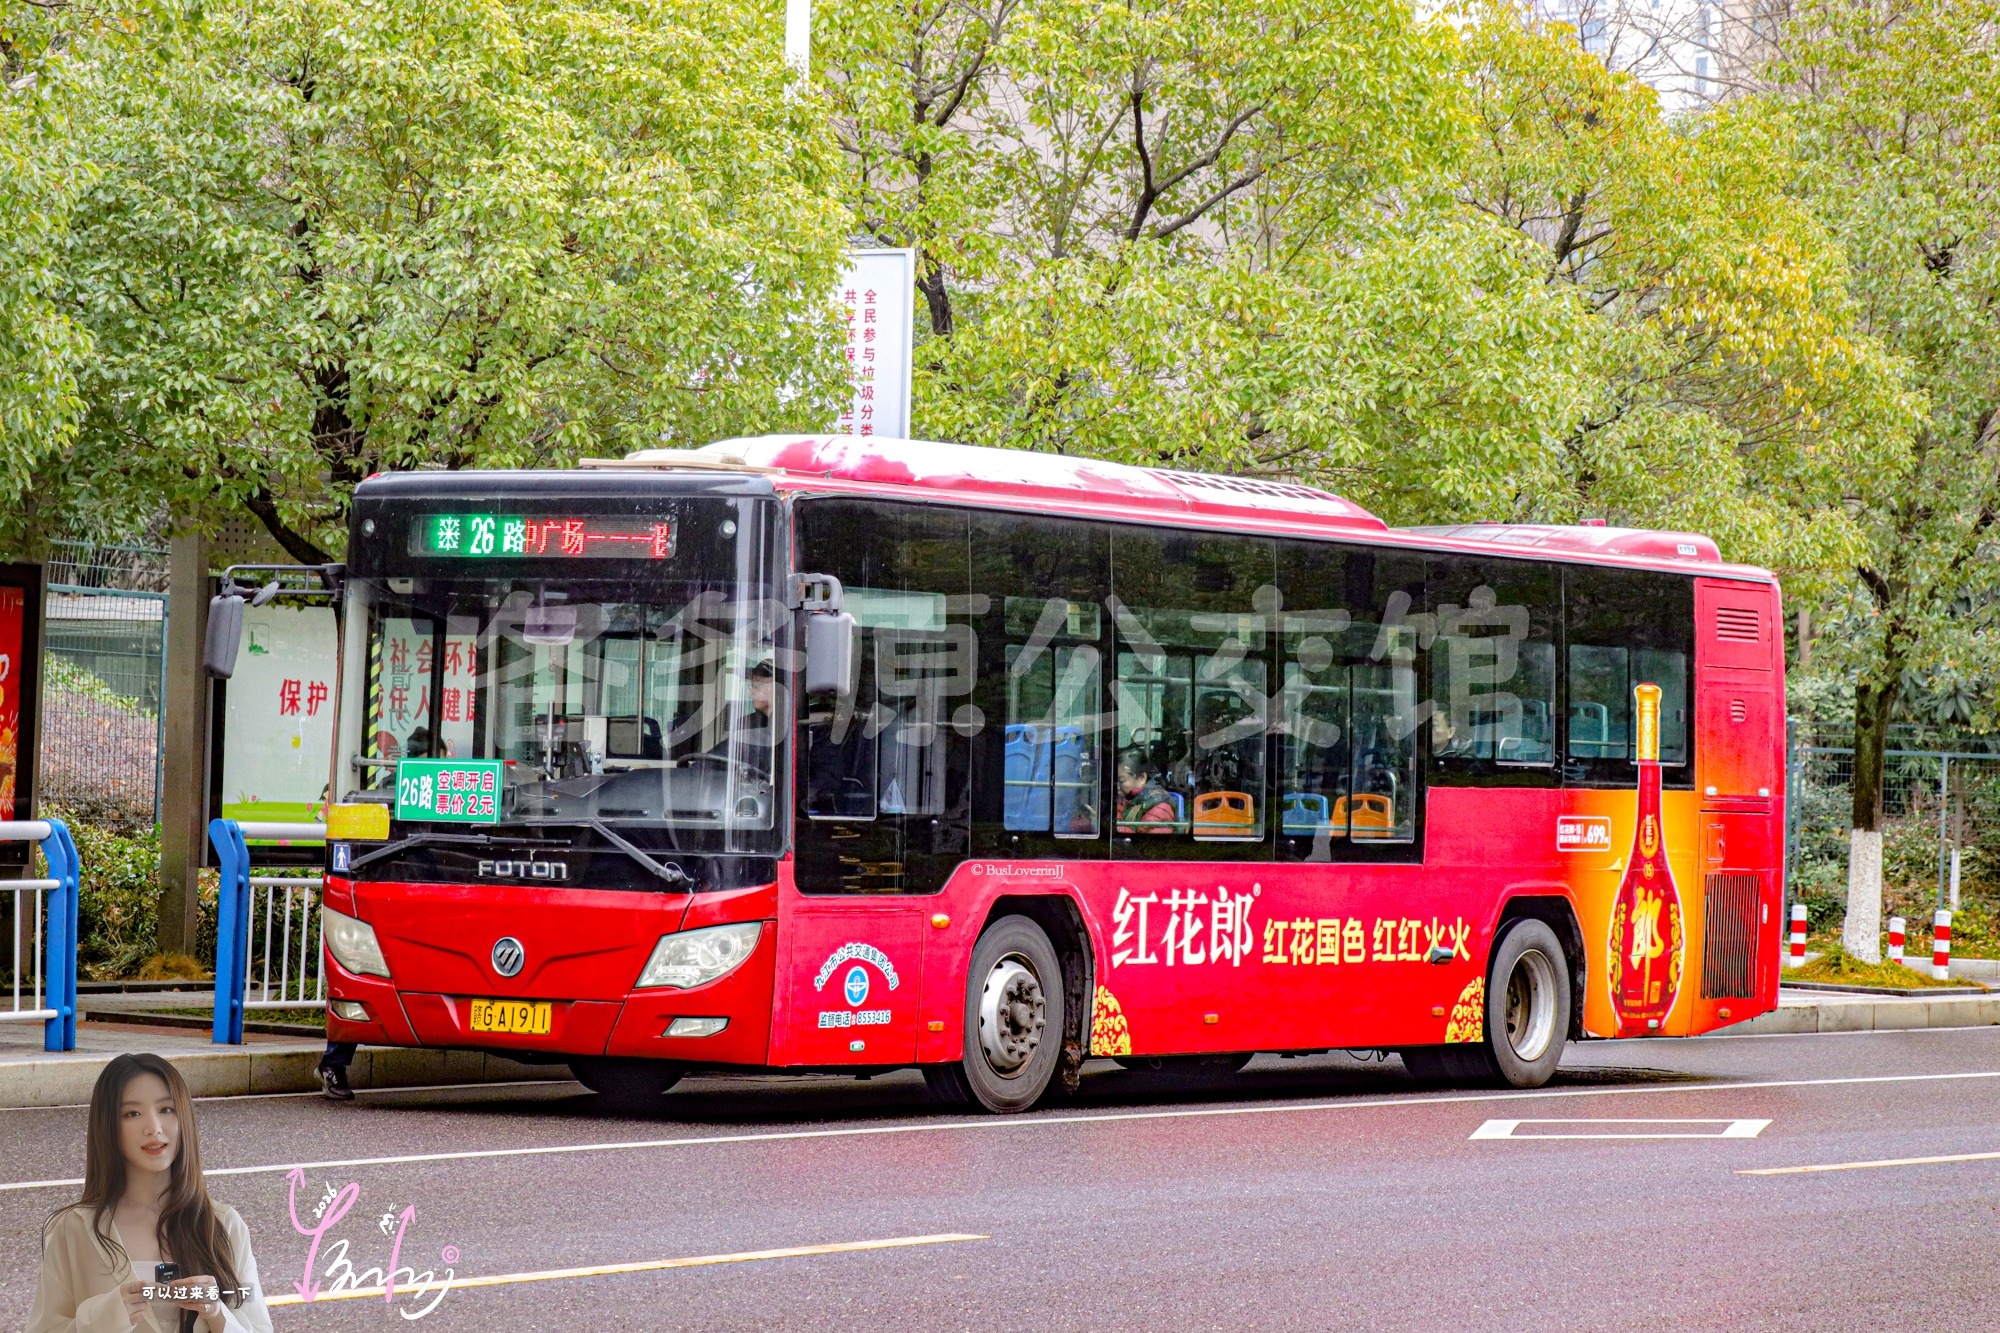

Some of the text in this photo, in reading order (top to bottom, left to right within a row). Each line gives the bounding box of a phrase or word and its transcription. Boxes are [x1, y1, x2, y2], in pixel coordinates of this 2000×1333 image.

[860, 288, 877, 437] 全民参与垃圾分类
[279, 678, 328, 716] 保护
[401, 774, 433, 809] 26路
[437, 770, 495, 792] 空调开启
[436, 794, 494, 815] 票价2元
[478, 860, 567, 879] FOTON
[1112, 886, 1255, 968] 红花郎
[1263, 916, 1471, 965] 红花国色 红红火火
[815, 943, 898, 990] 九江市公共交通集团公司
